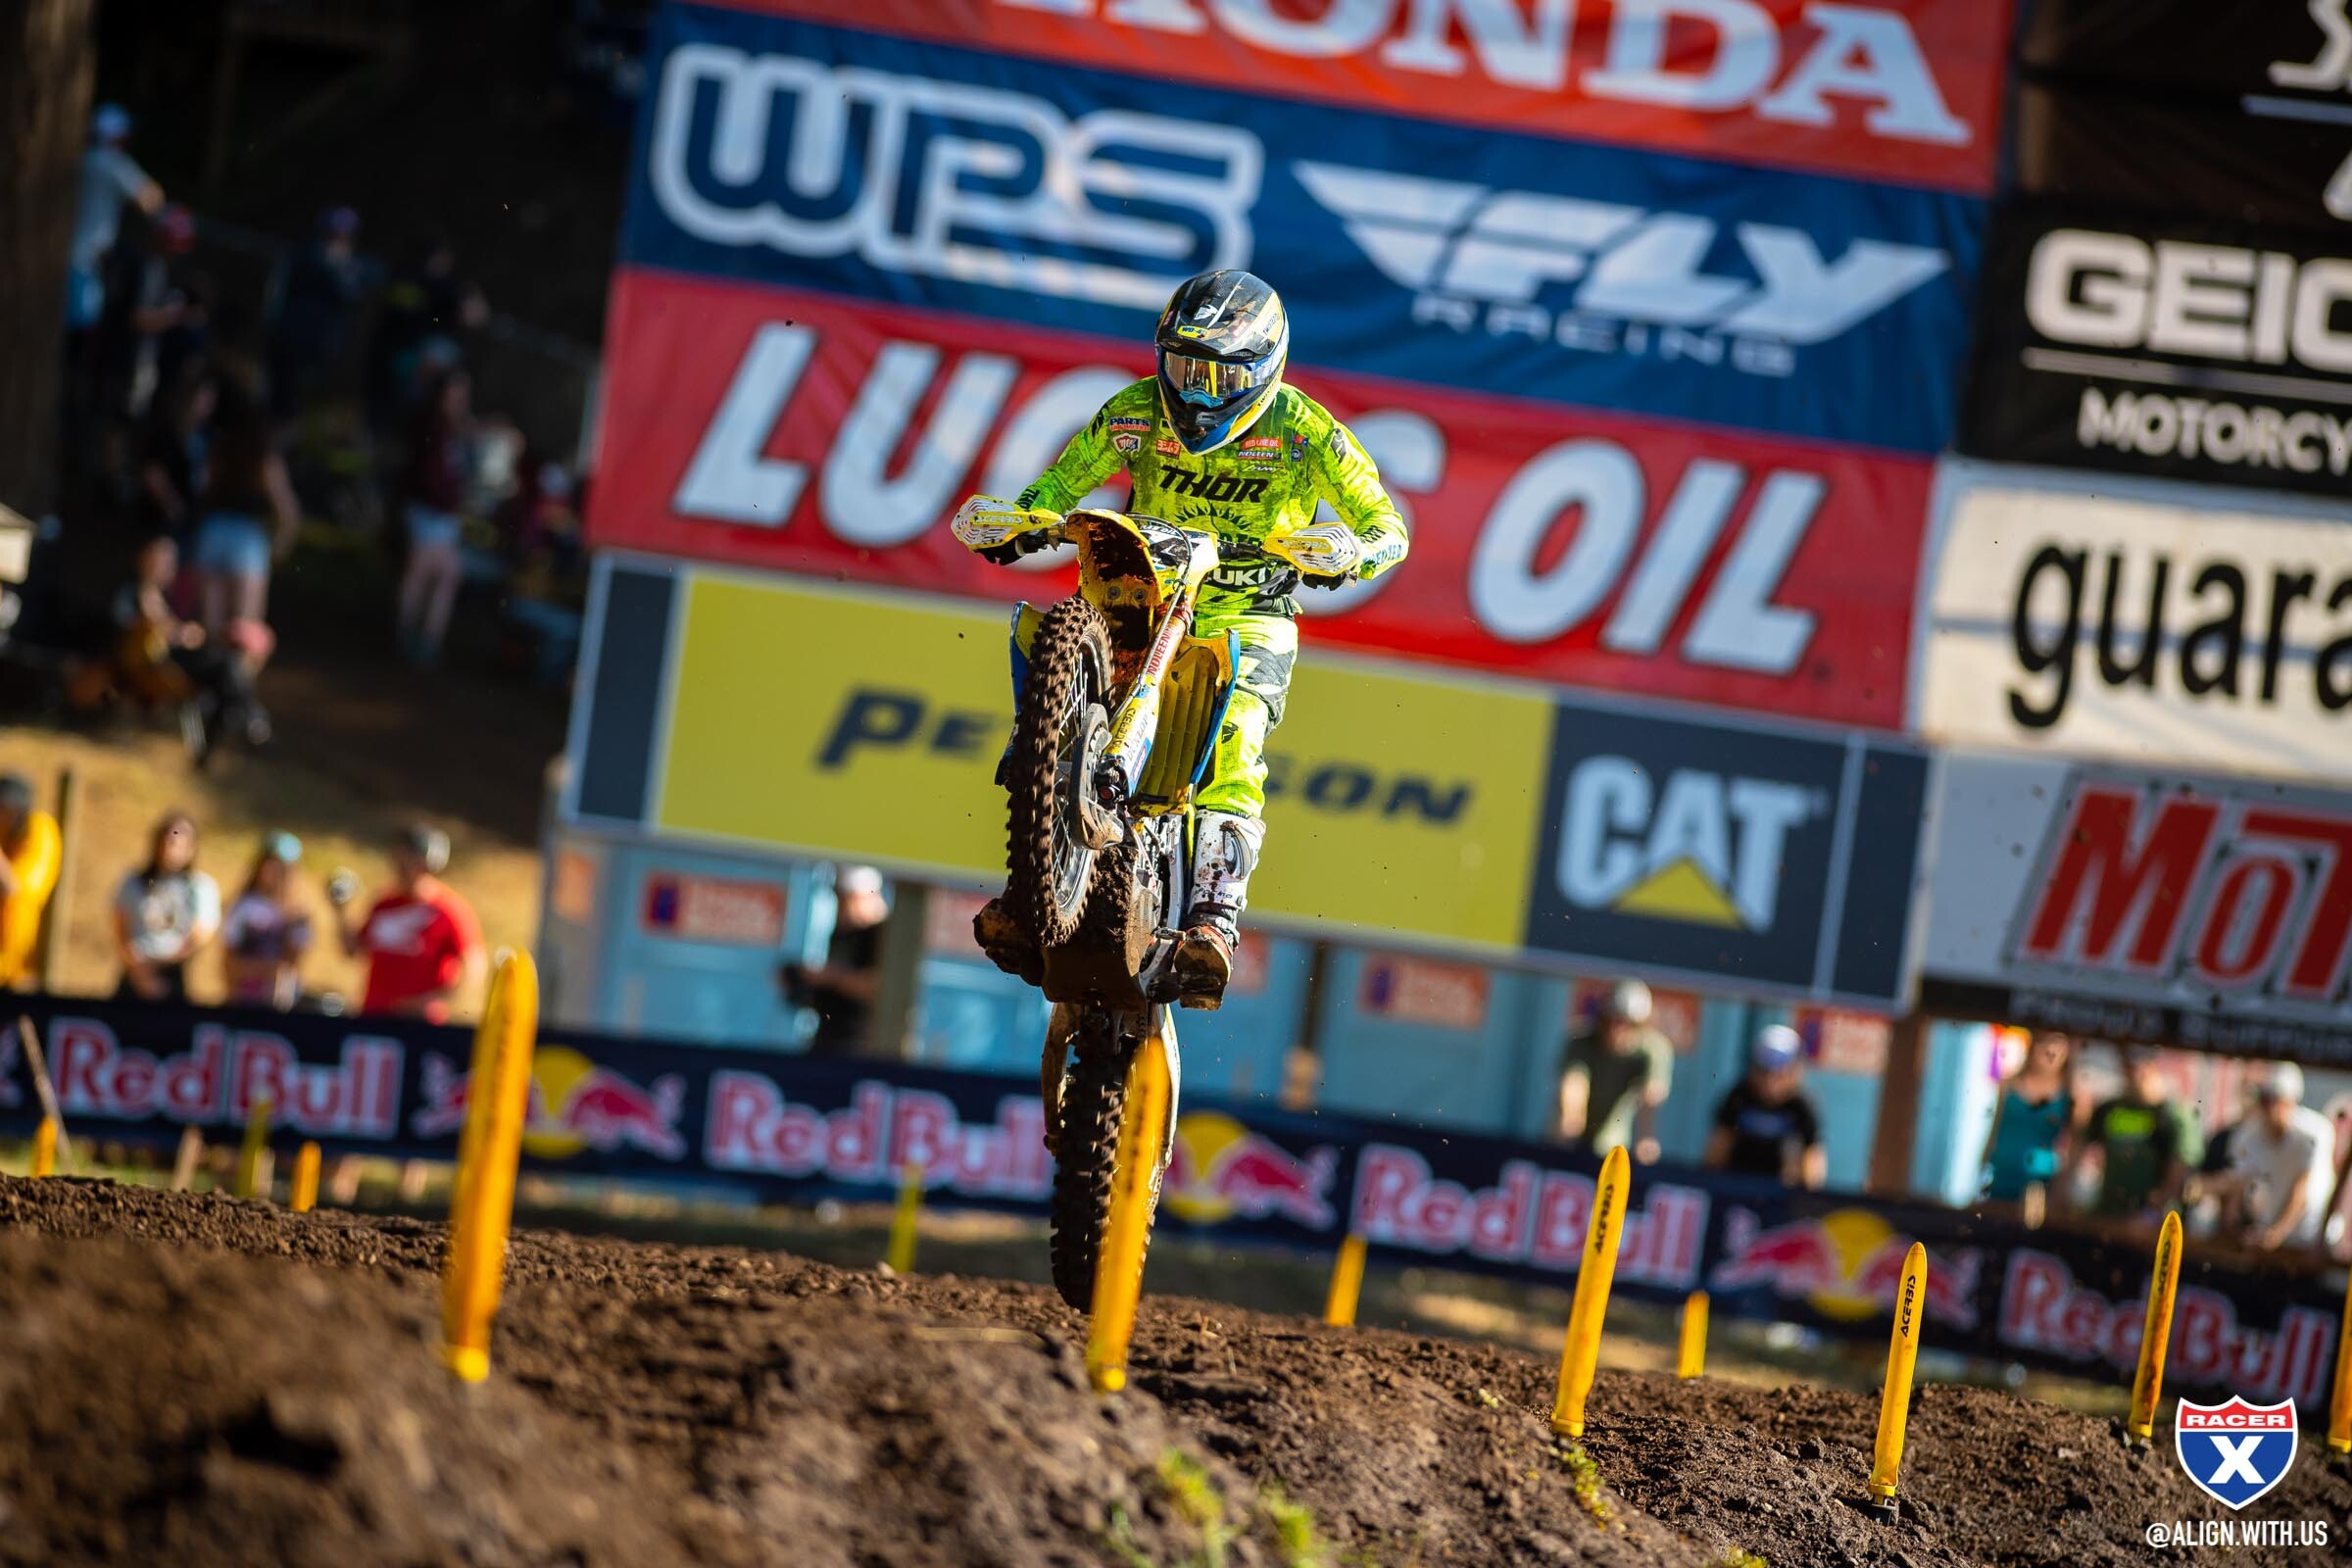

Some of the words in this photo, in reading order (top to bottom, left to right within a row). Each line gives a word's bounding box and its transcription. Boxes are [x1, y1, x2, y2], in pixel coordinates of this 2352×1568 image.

[648, 41, 1266, 308] WPS
[1292, 157, 1950, 346] FLY
[1412, 292, 1795, 377] RACING
[1159, 465, 1270, 503] THOR
[1212, 566, 1267, 587] UKI
[1465, 435, 1831, 676] OIL
[1556, 754, 1815, 934] CAT
[45, 1014, 228, 1126] Red
[229, 1029, 406, 1141] Bull
[702, 1068, 886, 1179] Red
[886, 1085, 1058, 1201] Bull
[1348, 1142, 1534, 1264] Red
[1593, 1182, 1616, 1255] ACERBIS
[1898, 1273, 1917, 1339] ACERBIS
